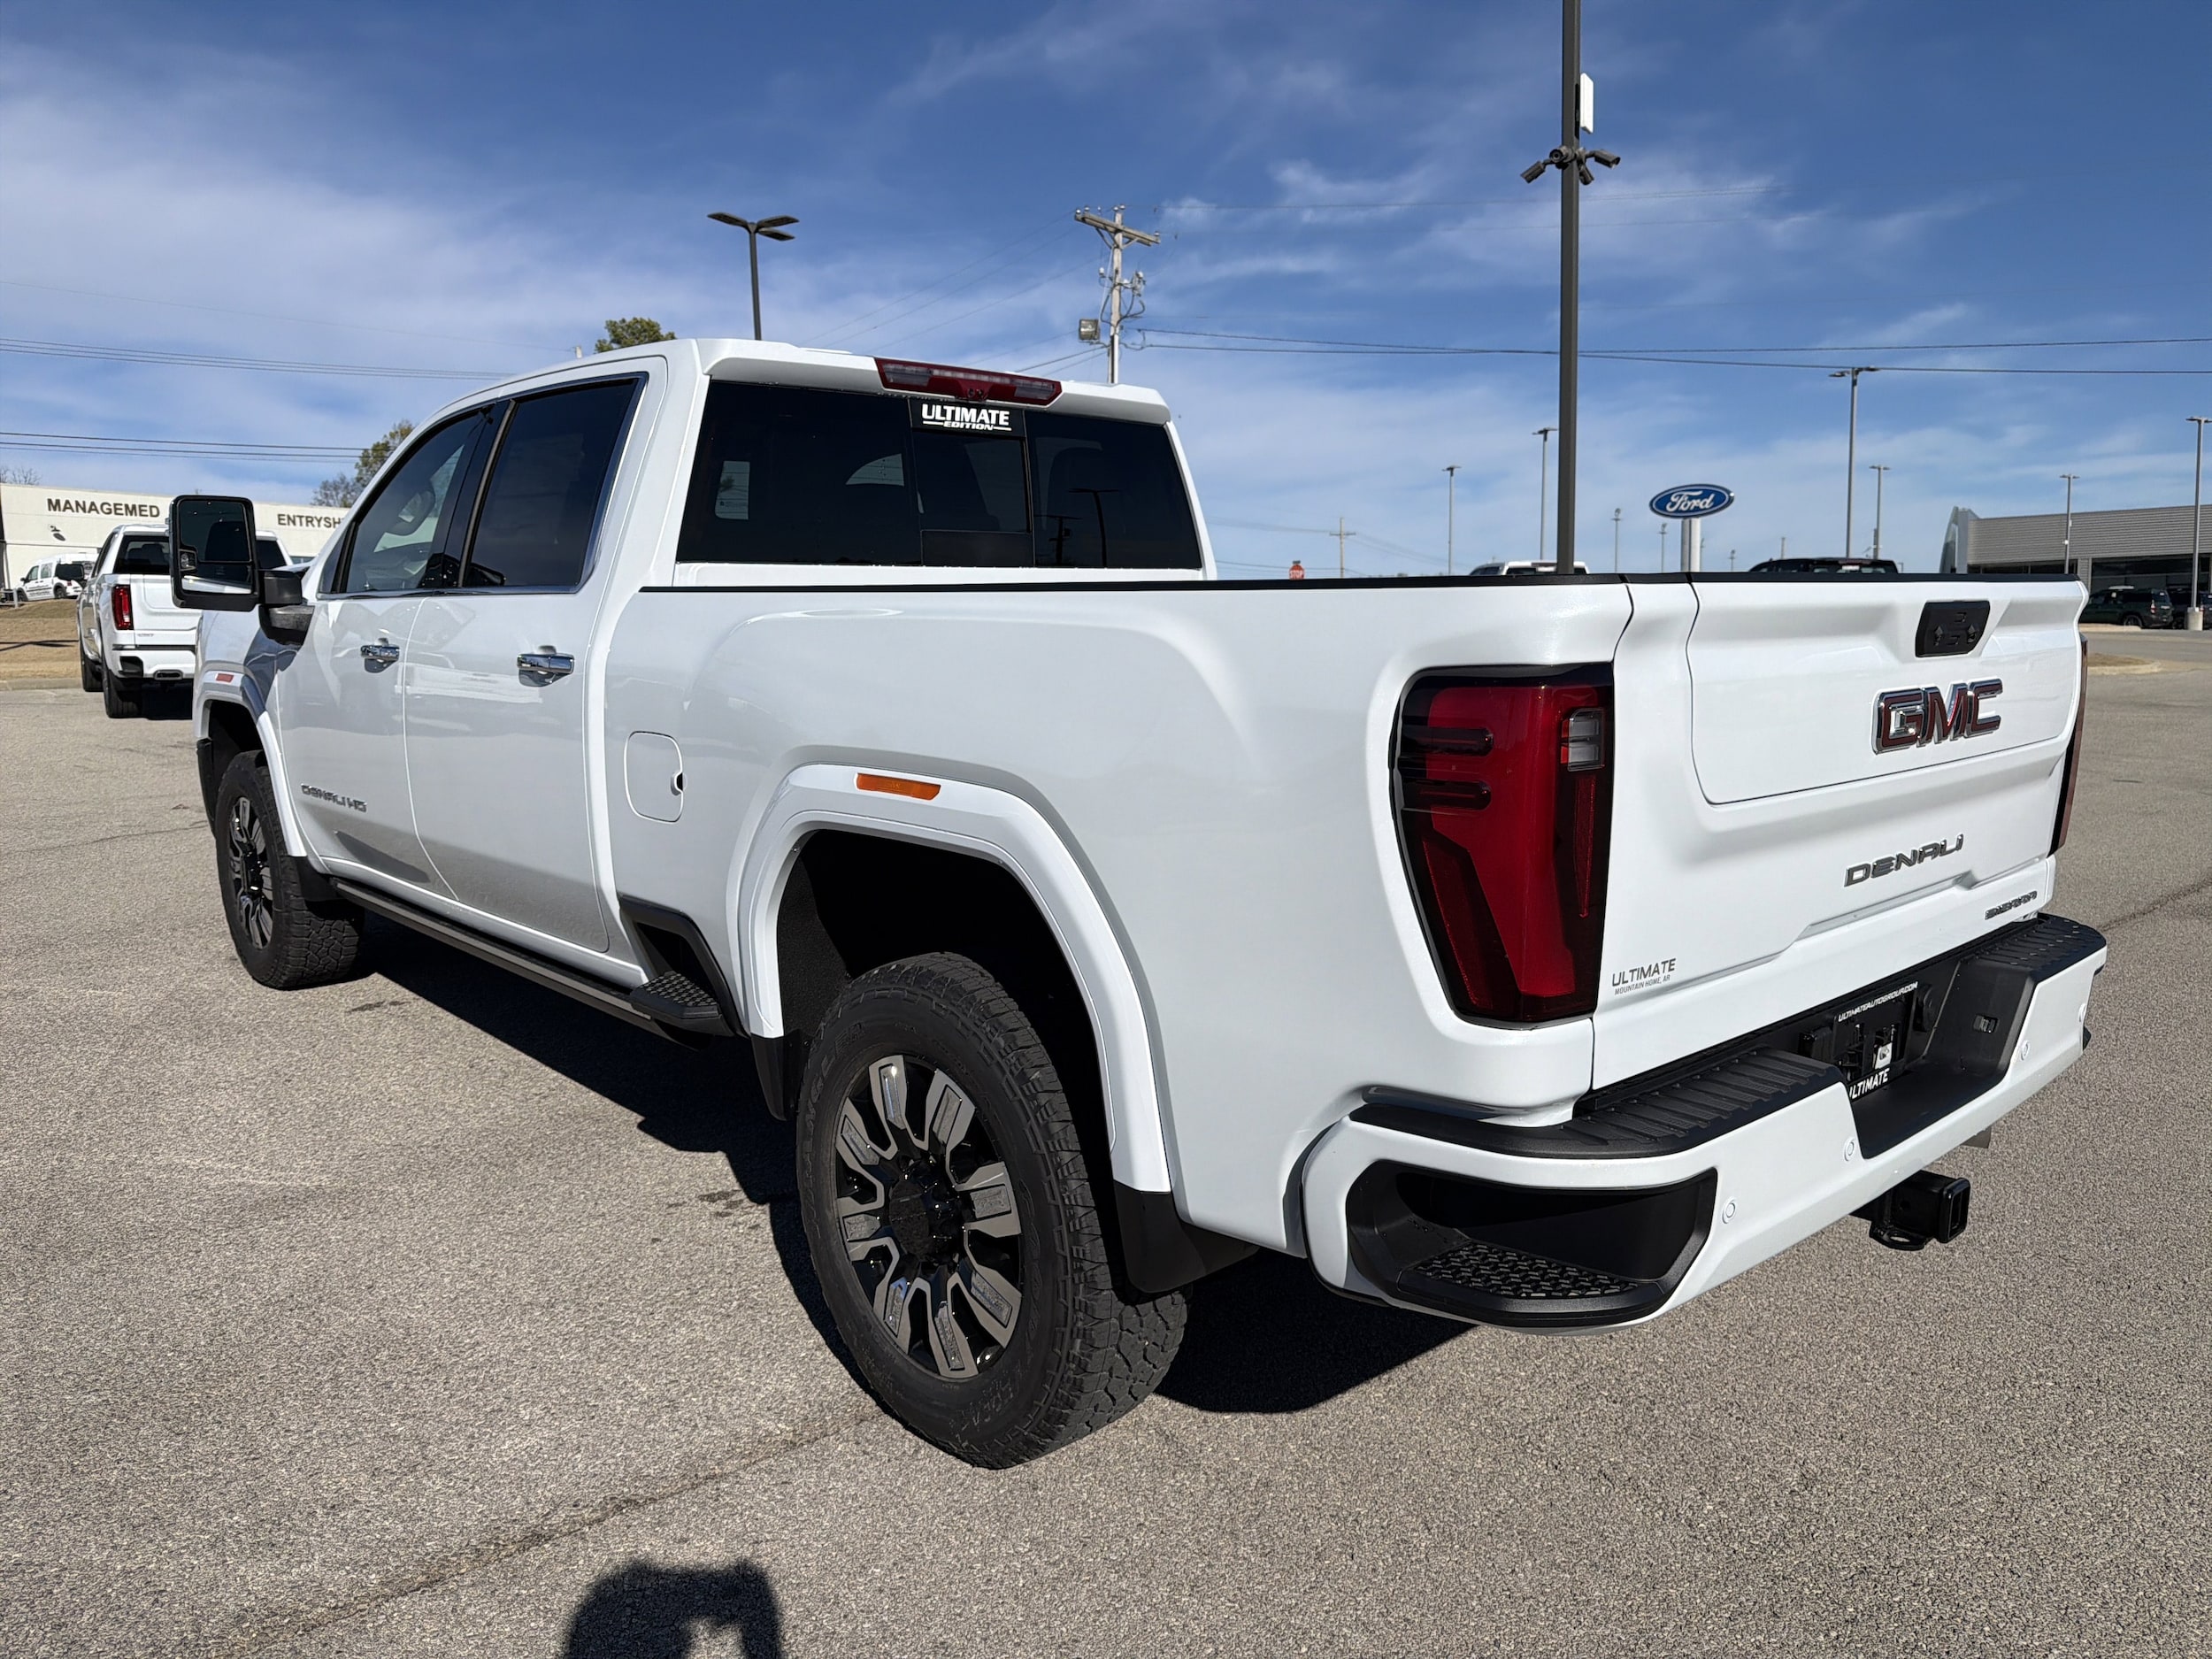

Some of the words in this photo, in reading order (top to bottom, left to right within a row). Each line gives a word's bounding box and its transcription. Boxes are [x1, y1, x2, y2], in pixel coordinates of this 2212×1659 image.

[921, 403, 1010, 426] ULTIMATE
[943, 422, 995, 431] EDITION
[46, 498, 161, 518] MANAGEMED
[1665, 490, 1715, 512] Ford
[277, 513, 344, 529] ENTRYSH
[1871, 678, 2003, 755] GMC
[1844, 833, 1964, 887] DENALI
[1612, 958, 1677, 987] ULTIMATE
[1614, 982, 1644, 996] MOUNTAIN
[1645, 978, 1662, 987] HOME,
[1663, 974, 1671, 983] AR
